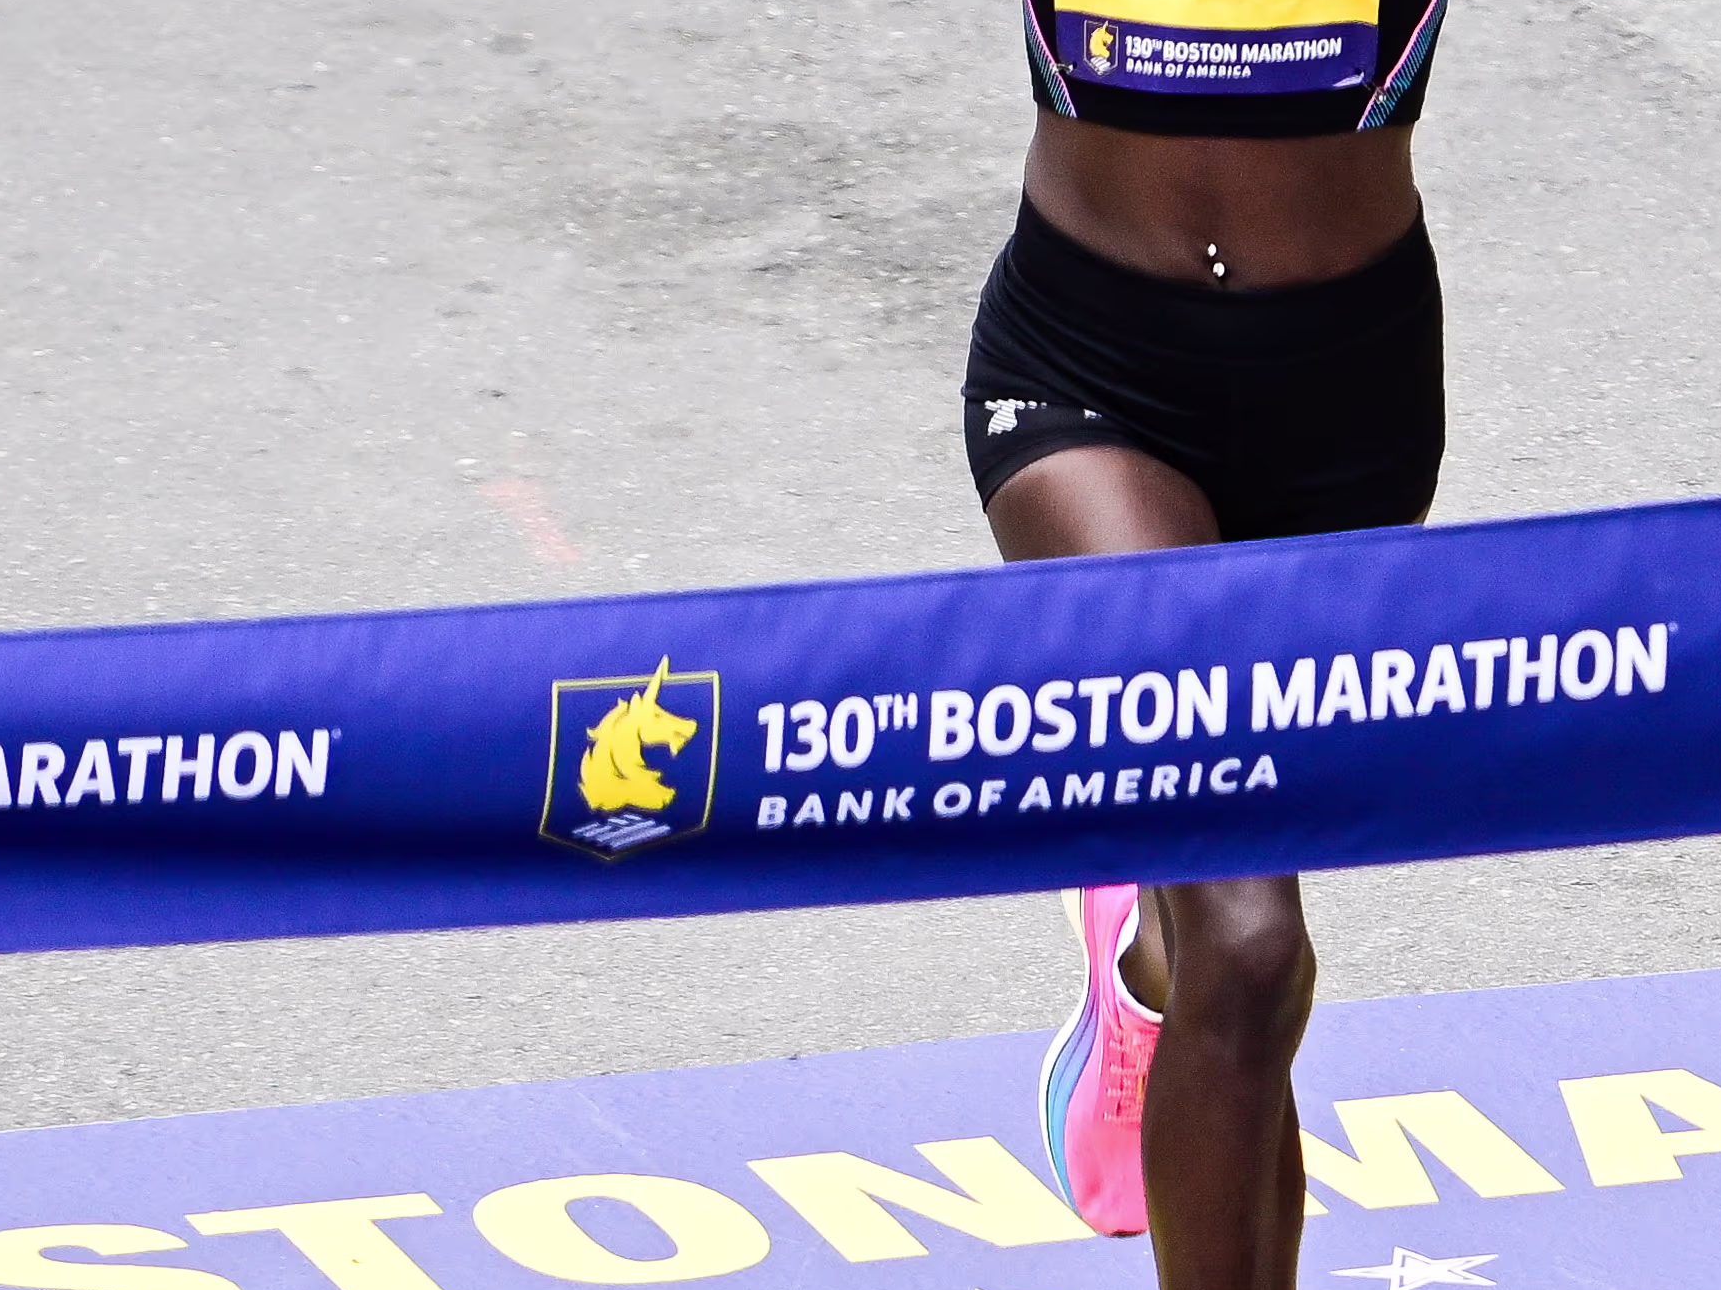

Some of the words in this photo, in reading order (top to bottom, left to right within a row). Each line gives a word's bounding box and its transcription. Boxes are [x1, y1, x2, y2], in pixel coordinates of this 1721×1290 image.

[929, 666, 1228, 761] BOSTON
[1252, 623, 1667, 732] MARATHON
[758, 787, 914, 826] BANK
[934, 780, 1006, 816] OF
[1019, 755, 1277, 810] AMERICA
